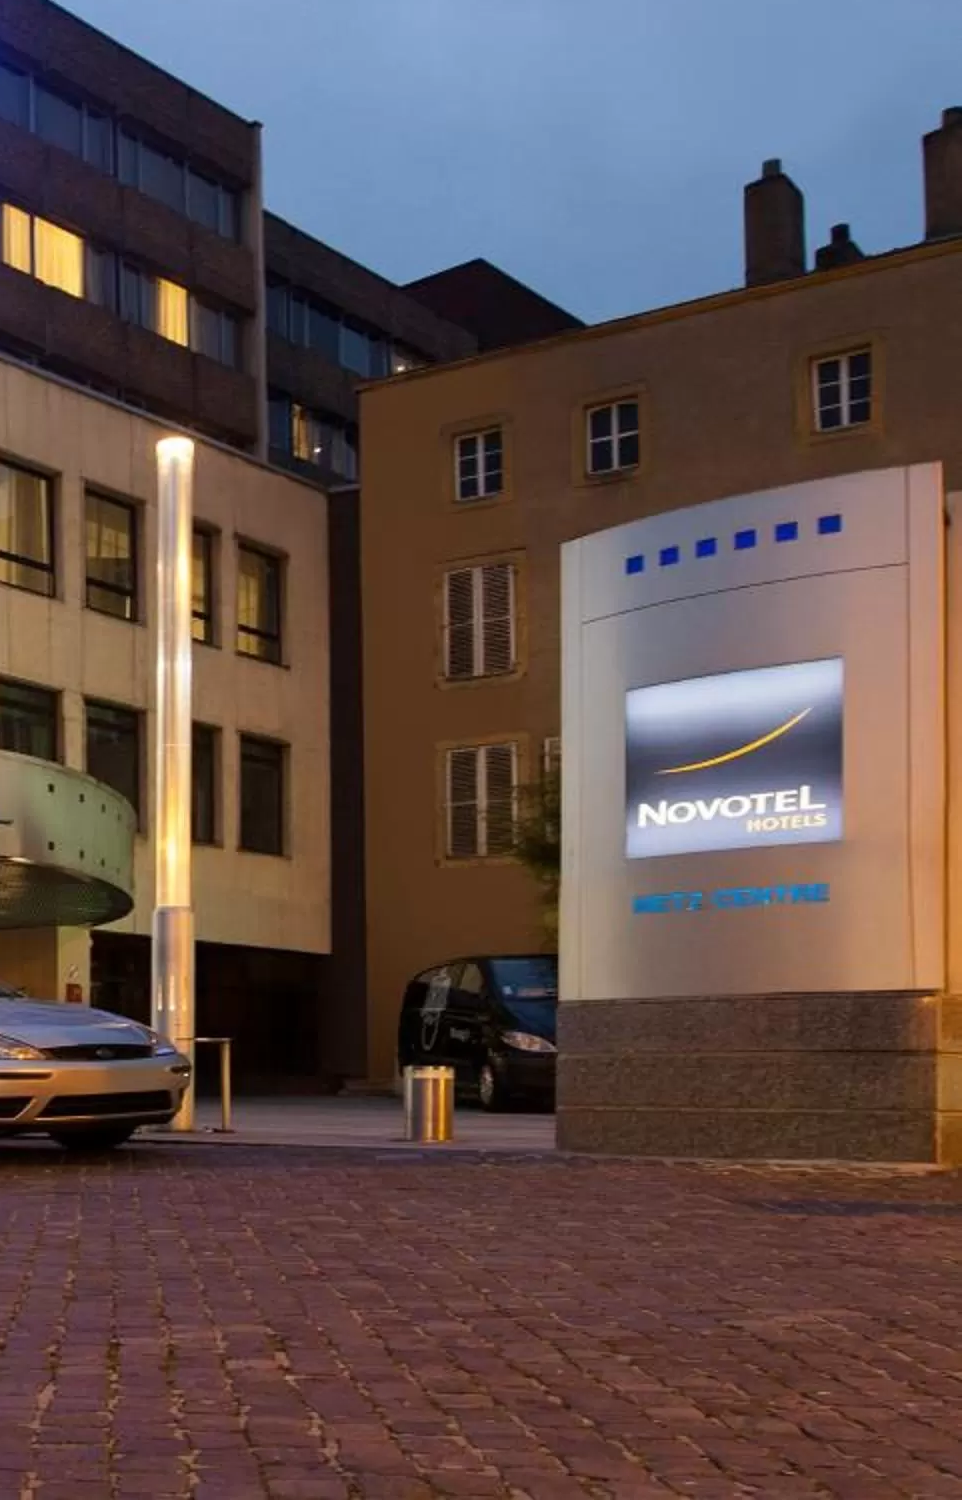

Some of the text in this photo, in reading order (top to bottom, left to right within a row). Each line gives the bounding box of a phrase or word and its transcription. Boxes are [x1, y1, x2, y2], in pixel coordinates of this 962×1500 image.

[638, 785, 827, 828] NOVOTEL
[746, 813, 827, 833] HOTELS
[711, 883, 830, 909] CENTRE
